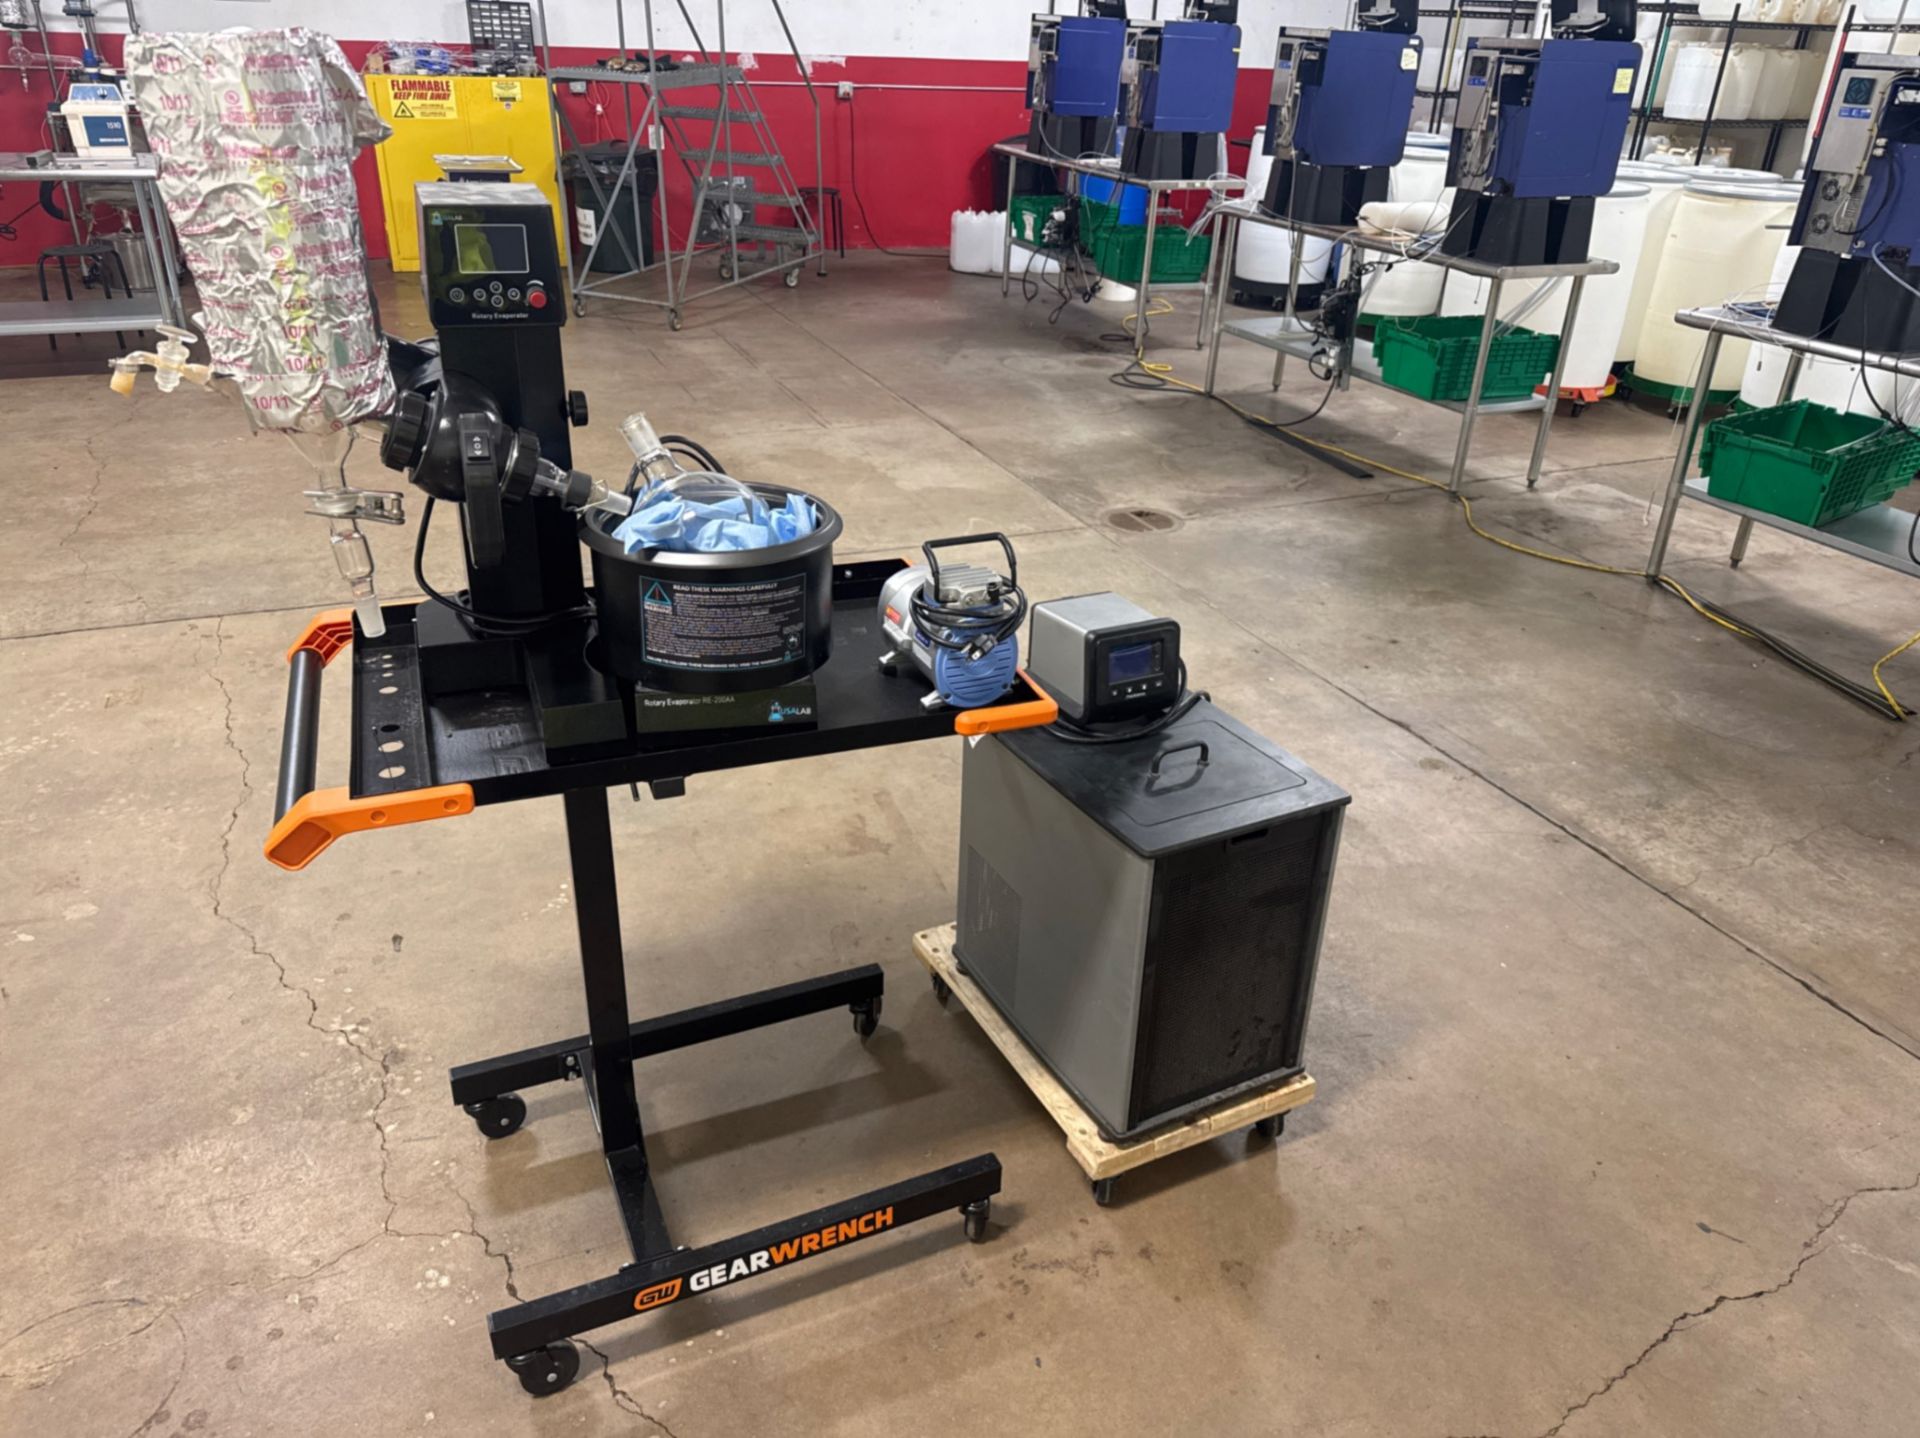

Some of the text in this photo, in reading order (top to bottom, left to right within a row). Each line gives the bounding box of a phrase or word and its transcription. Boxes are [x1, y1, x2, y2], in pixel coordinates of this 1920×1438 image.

[391, 80, 451, 92] FLAMMABLE
[393, 92, 451, 100] KEEP FIRE AWAY
[282, 322, 319, 340] 10/11
[253, 395, 289, 409] 10/11
[673, 584, 690, 592] READ
[712, 585, 746, 593] WARNINGS
[747, 583, 778, 591] CAREFULLY
[644, 699, 666, 708] Rotary
[667, 698, 701, 706] Evaporator
[781, 706, 812, 716] USALAB
[689, 1206, 894, 1293] GEARWRENCH
